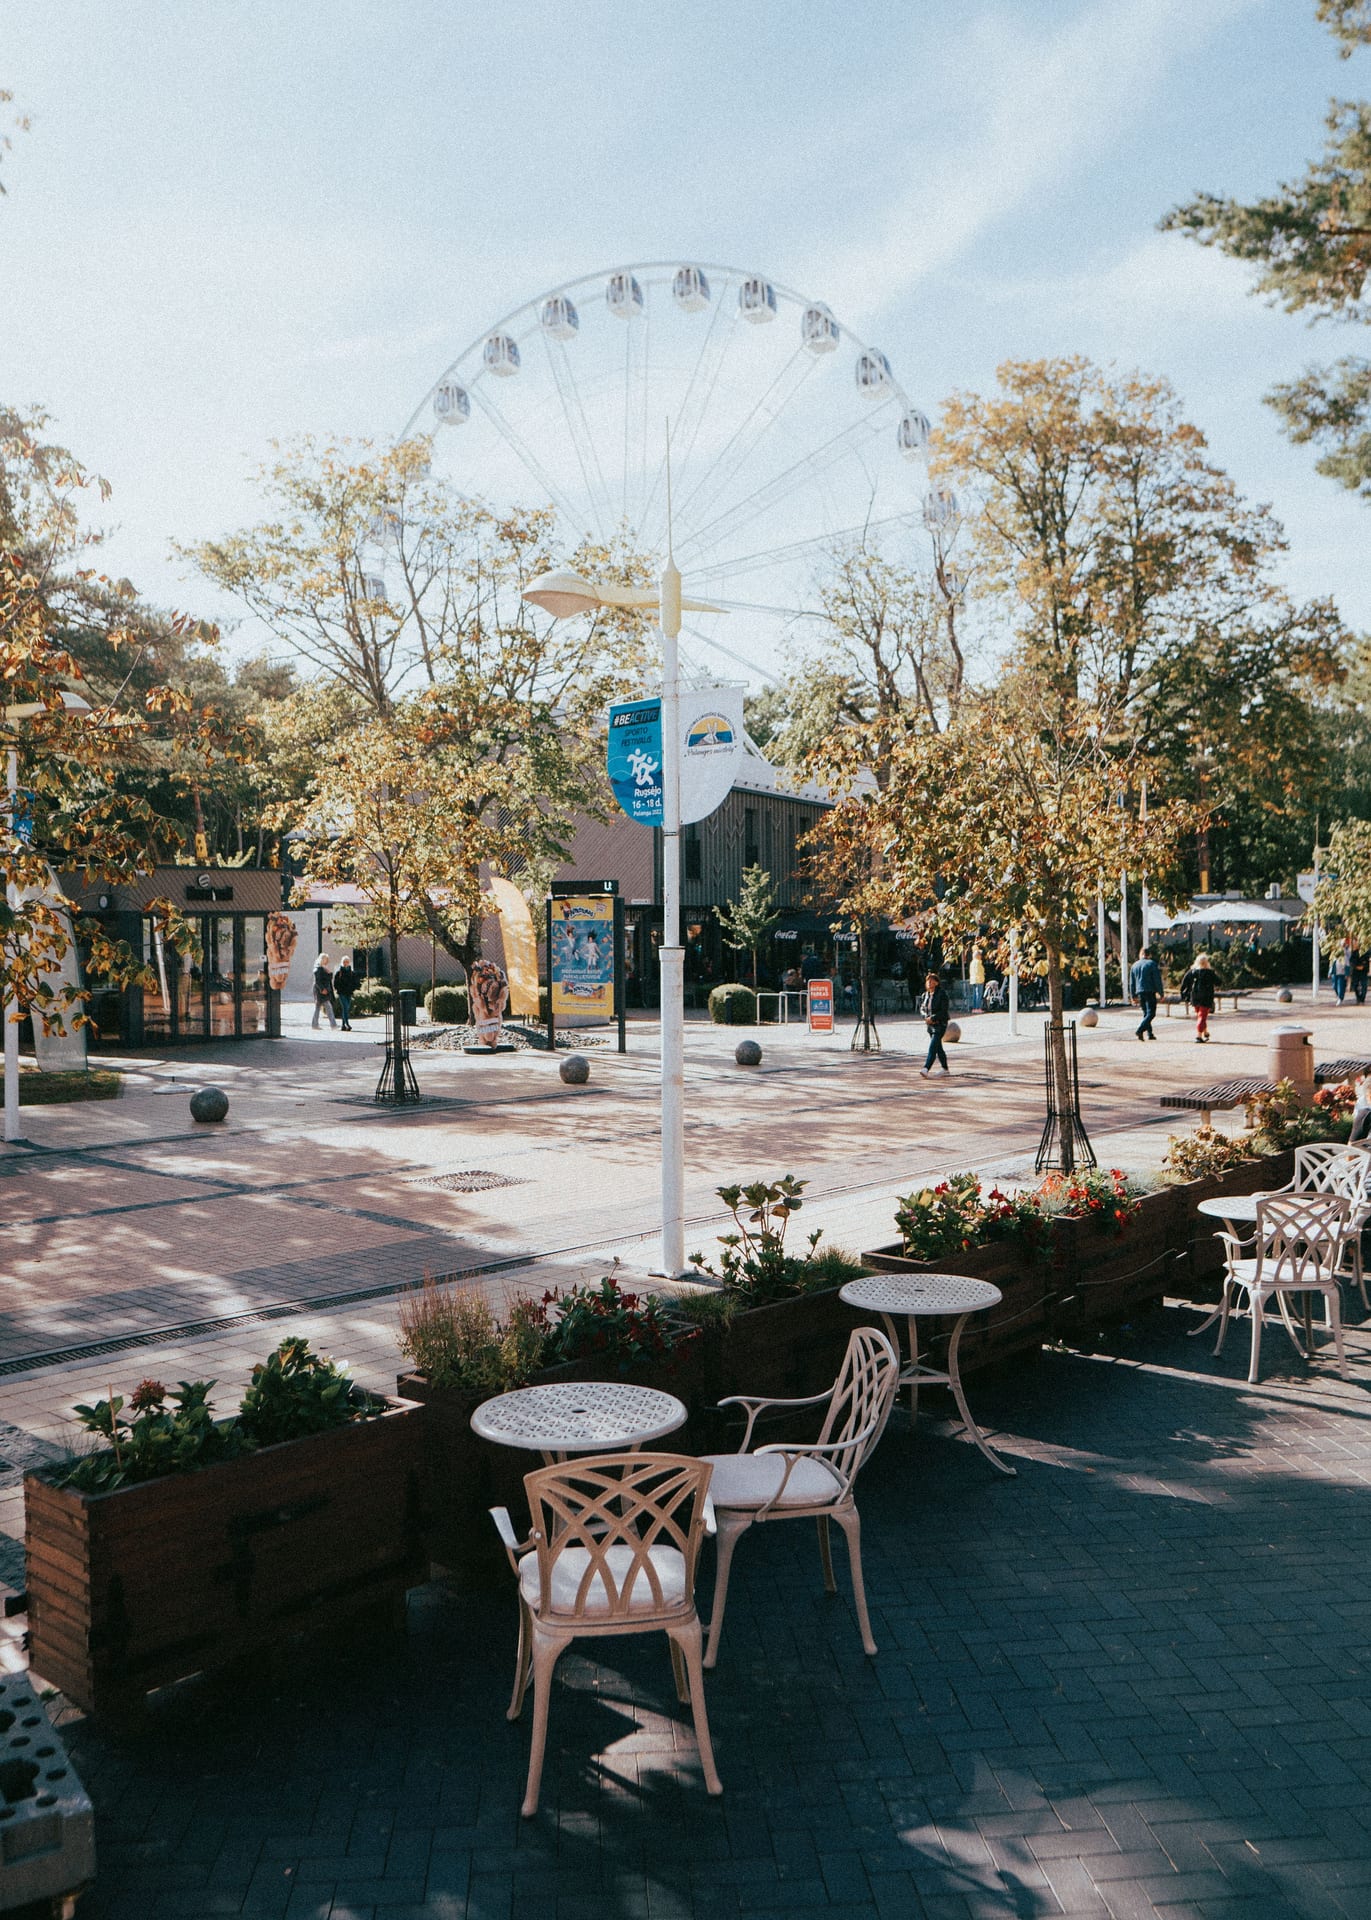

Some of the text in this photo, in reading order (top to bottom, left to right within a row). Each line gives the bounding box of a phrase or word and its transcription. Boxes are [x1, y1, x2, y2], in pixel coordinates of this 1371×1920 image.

[614, 710, 658, 726] #BEACTIVE
[634, 786, 662, 798] Rugsėjo
[632, 800, 641, 809] 16
[647, 799, 654, 807] 18
[774, 929, 798, 940] Coca-Cola
[832, 931, 857, 941] Coca-Cola
